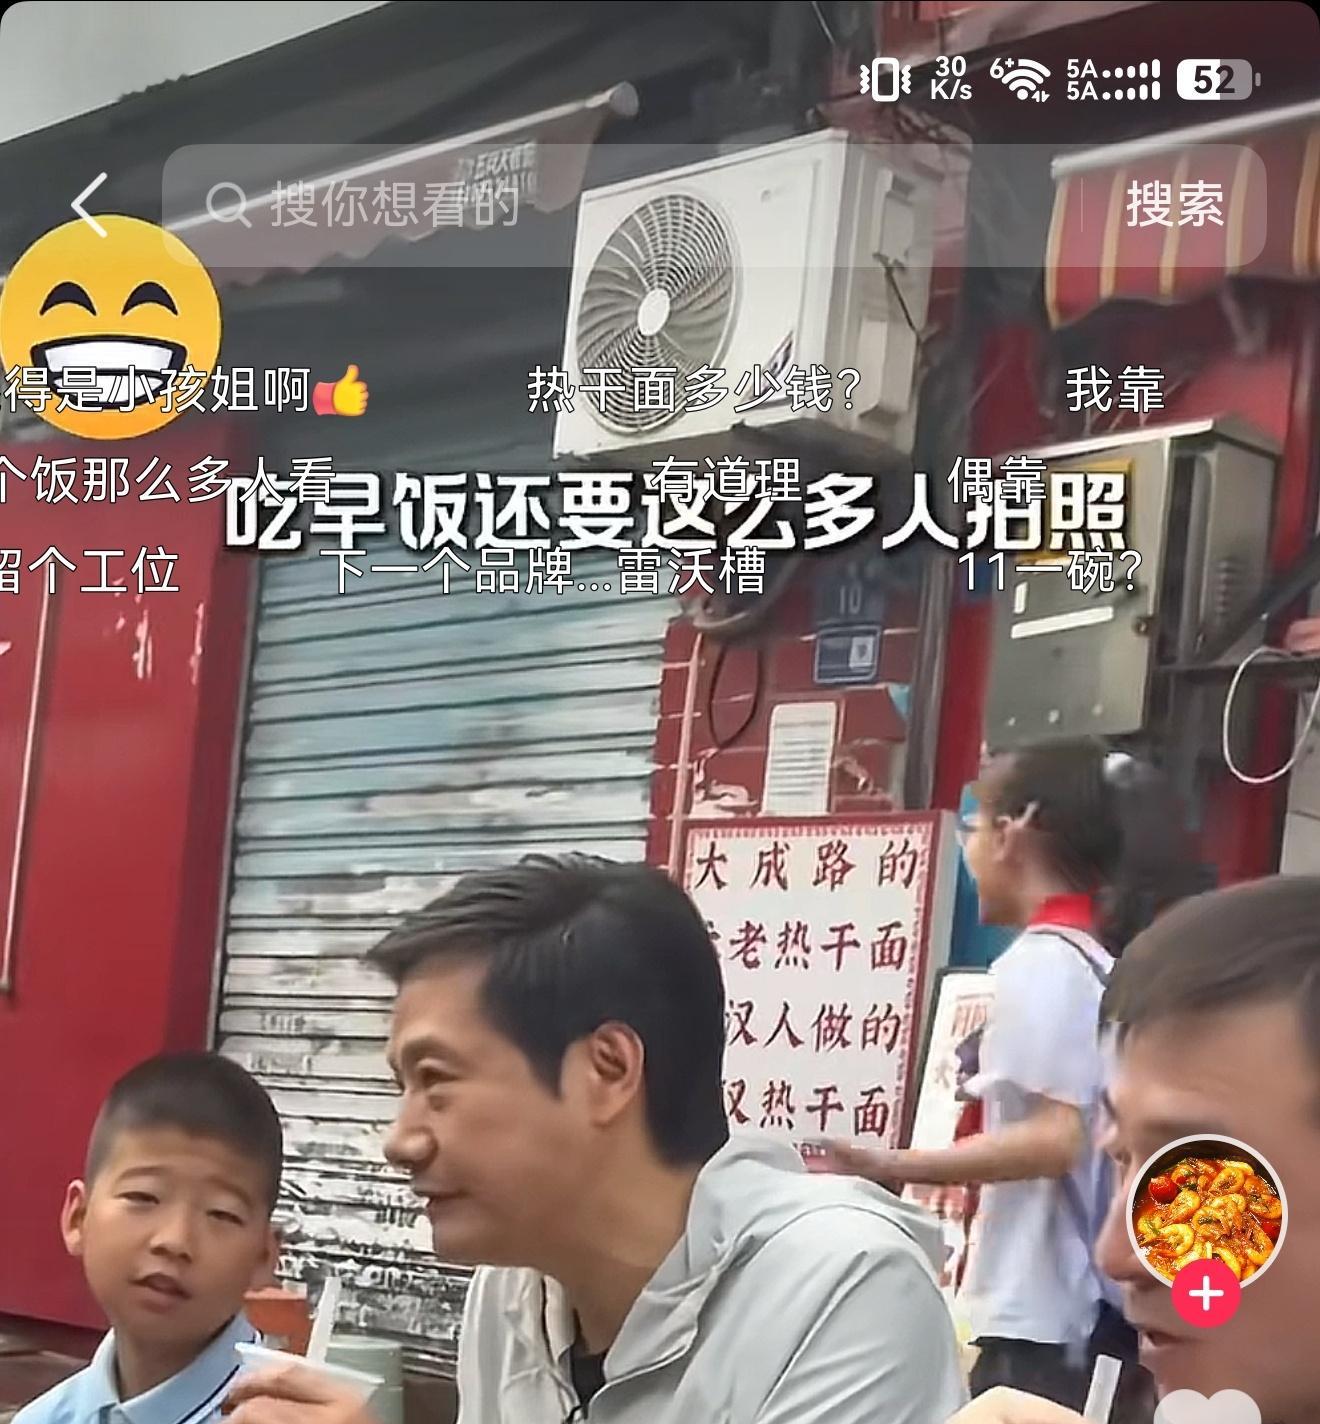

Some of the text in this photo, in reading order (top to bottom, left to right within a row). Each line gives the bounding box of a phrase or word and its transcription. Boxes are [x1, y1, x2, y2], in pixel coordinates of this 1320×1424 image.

[695, 838, 919, 892] 大成路的
[705, 920, 909, 971] 老热干面
[724, 999, 901, 1053] 汉人做的
